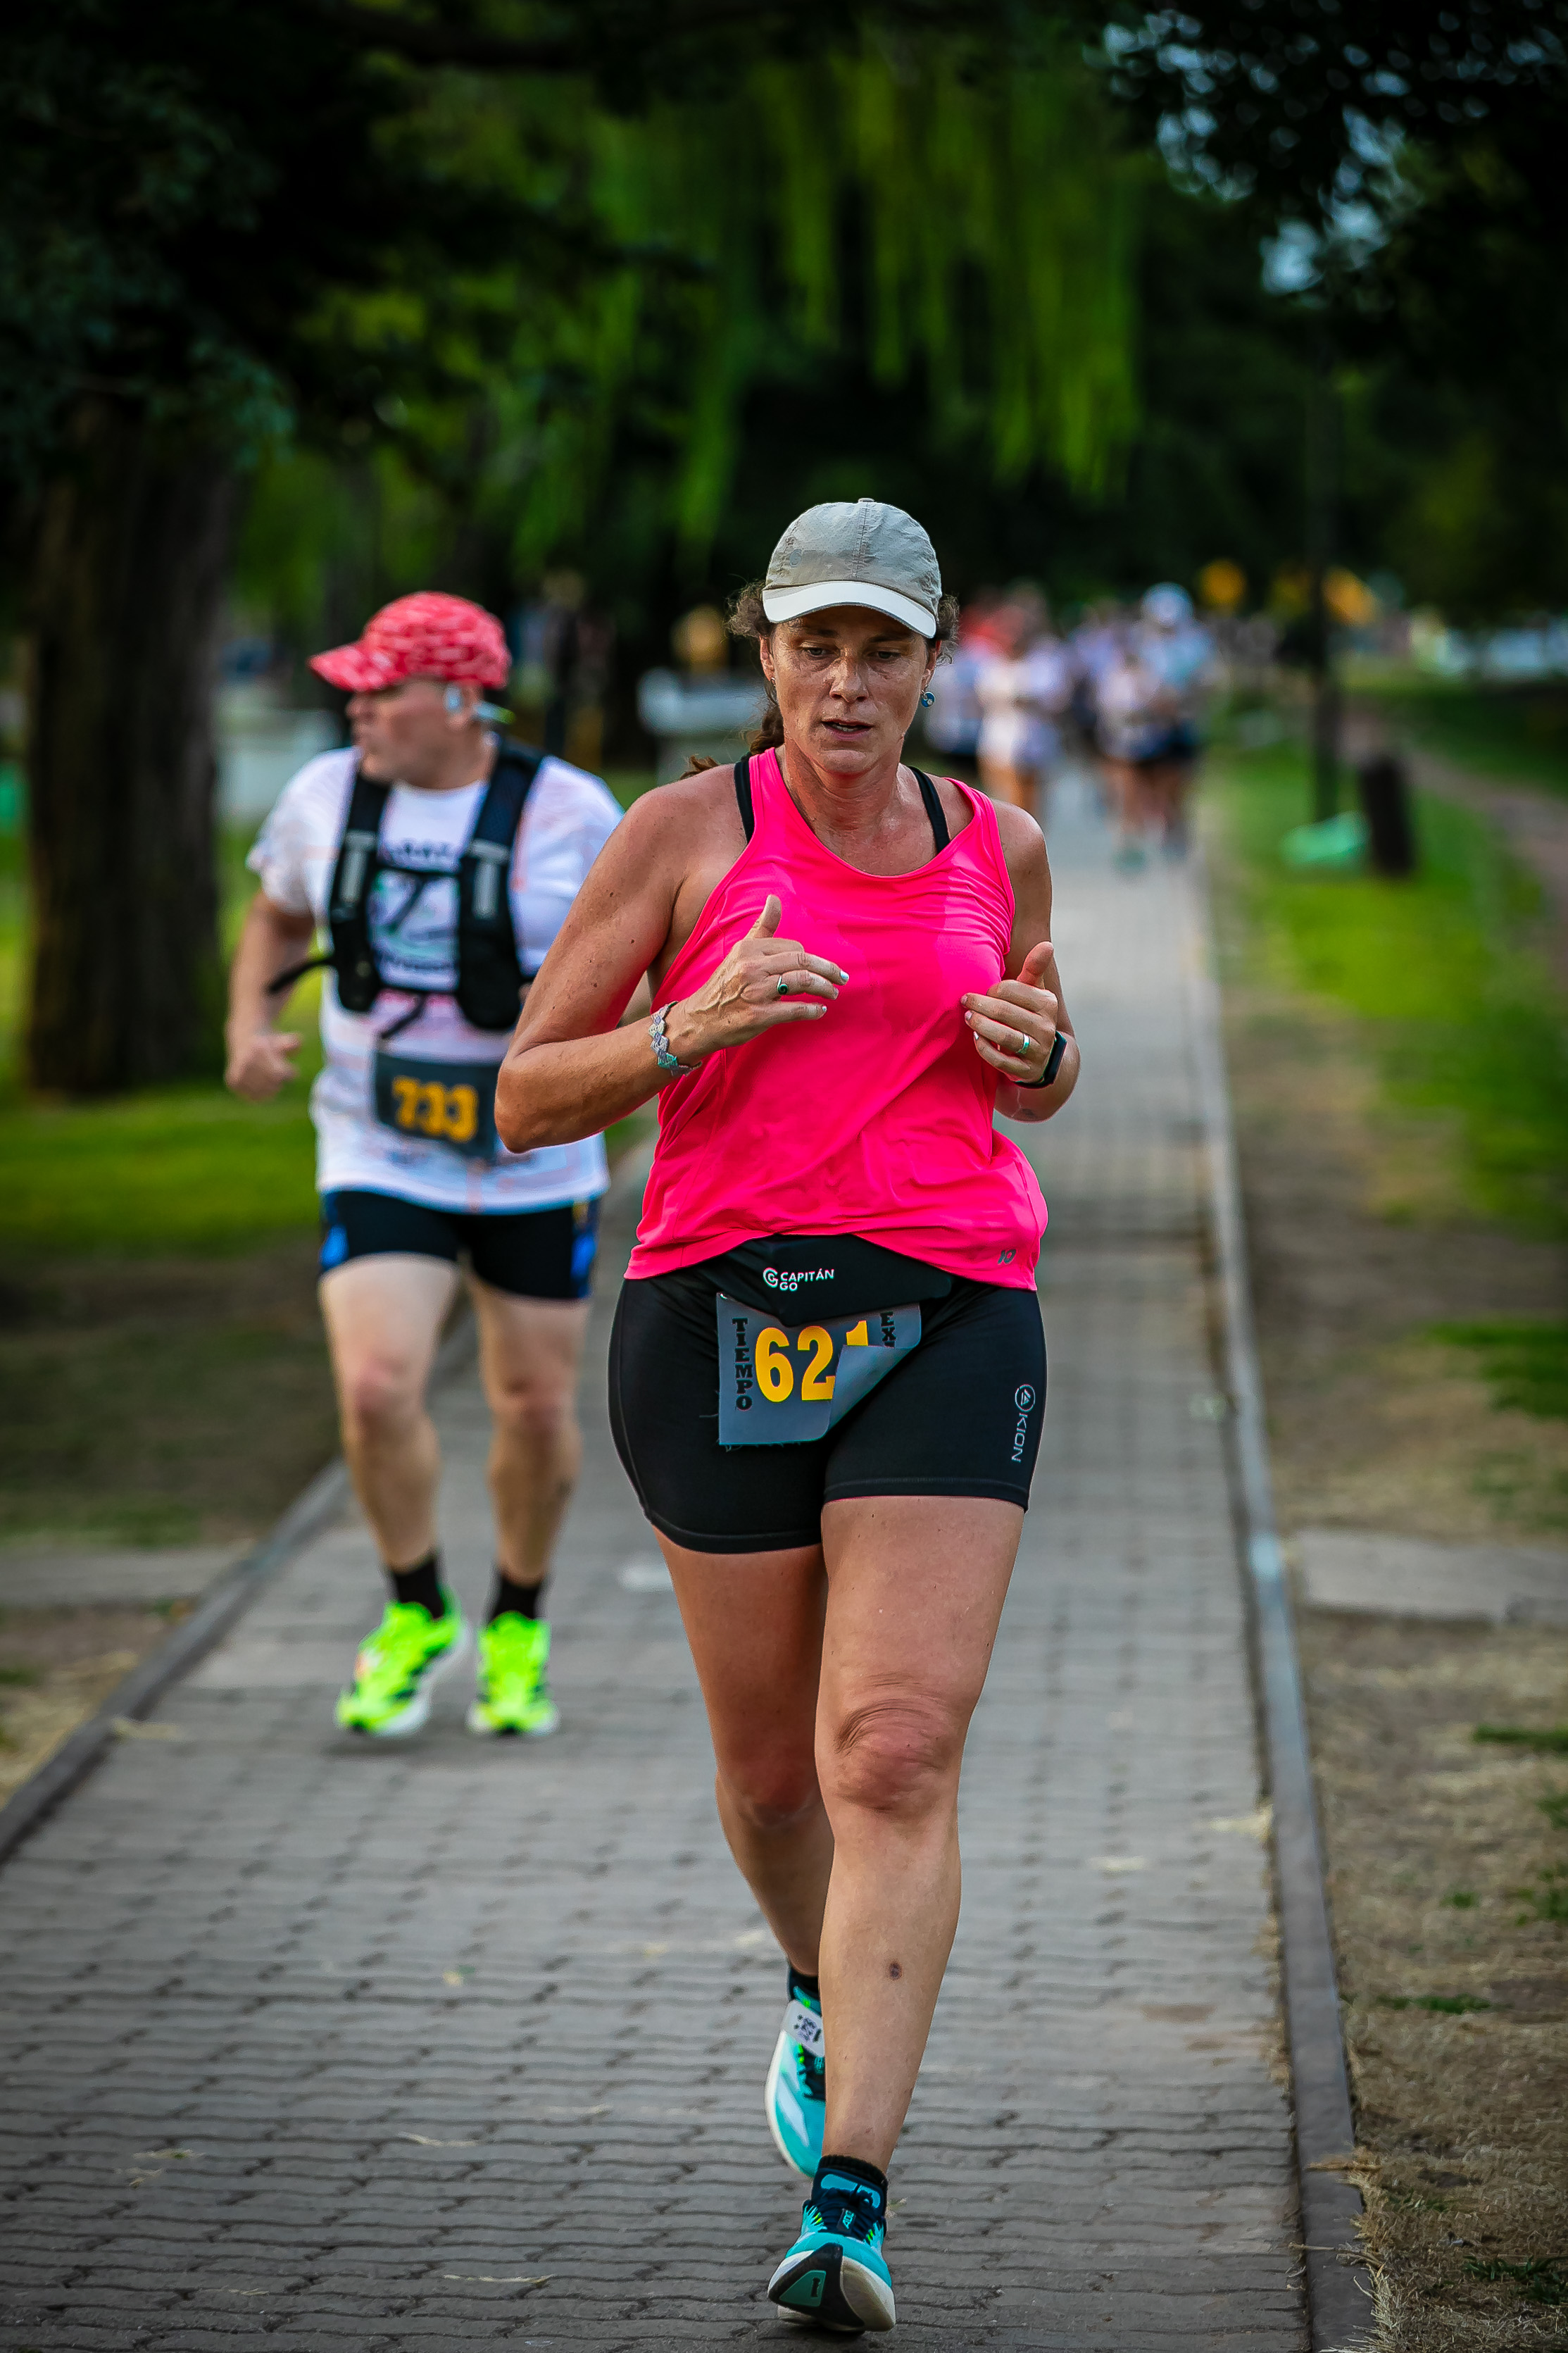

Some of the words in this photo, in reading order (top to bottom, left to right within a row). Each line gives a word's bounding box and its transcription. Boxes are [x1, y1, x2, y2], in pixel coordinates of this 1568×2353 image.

[780, 1268, 834, 1282] CAPITÁN
[779, 1282, 798, 1292] GO
[732, 1317, 753, 1411] TIEMPO
